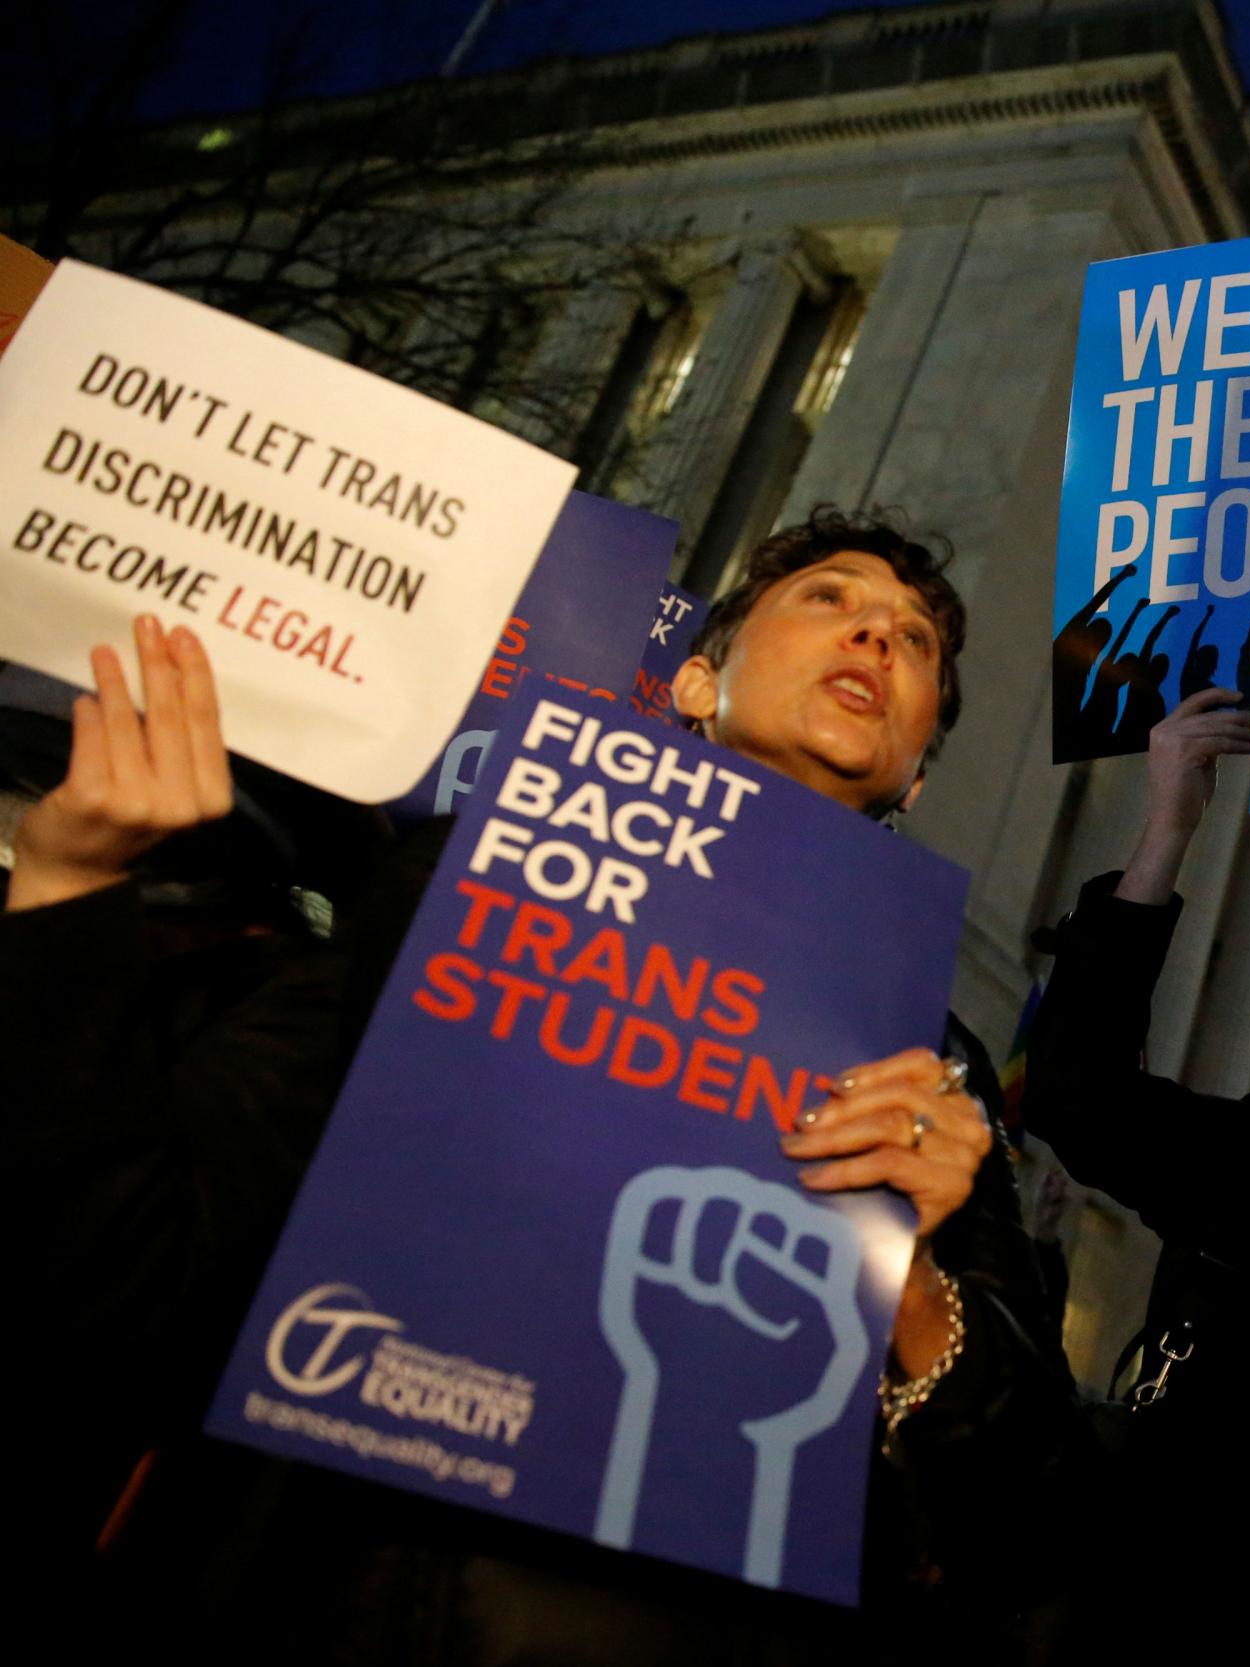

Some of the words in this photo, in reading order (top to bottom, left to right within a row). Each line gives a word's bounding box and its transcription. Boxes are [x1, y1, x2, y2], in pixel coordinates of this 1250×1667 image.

[42, 427, 427, 614] DISCRIMINATION
[79, 353, 228, 438] DON'T
[227, 410, 315, 475] LET
[318, 445, 466, 540] TRANS
[11, 509, 218, 614] BECOME
[216, 586, 364, 684] LEGAL.
[496, 757, 725, 878] BACK
[521, 700, 761, 822] FIGHT
[468, 817, 648, 924] FOR
[455, 880, 766, 1036] TRANS
[412, 952, 832, 1133] STUDEN
